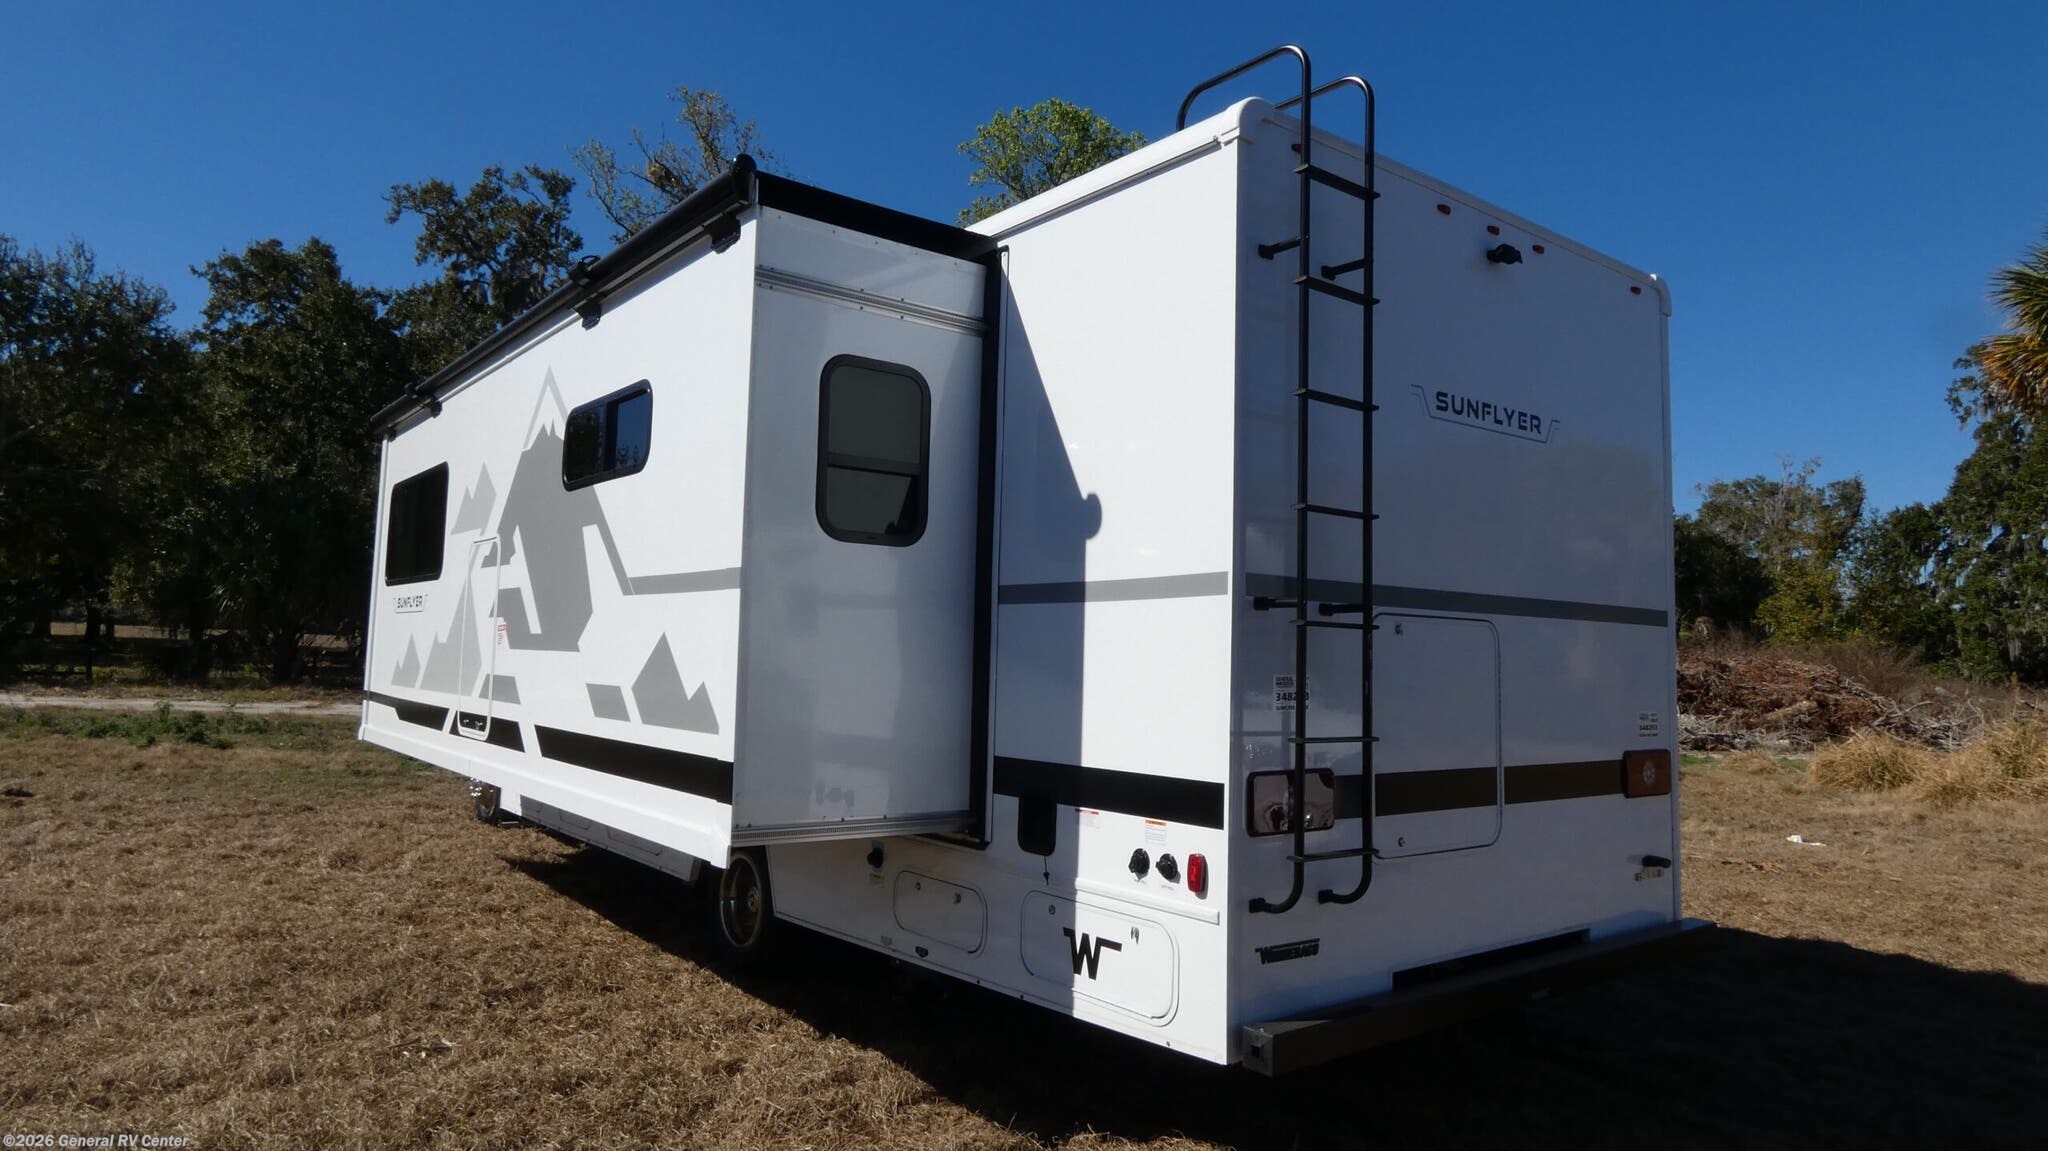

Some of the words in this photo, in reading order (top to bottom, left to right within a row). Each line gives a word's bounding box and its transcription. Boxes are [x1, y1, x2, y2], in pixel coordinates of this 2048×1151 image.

[1435, 391, 1542, 434] SUNFLYER
[397, 595, 423, 609] SUNFLYER
[1275, 692, 1309, 701] 34823
